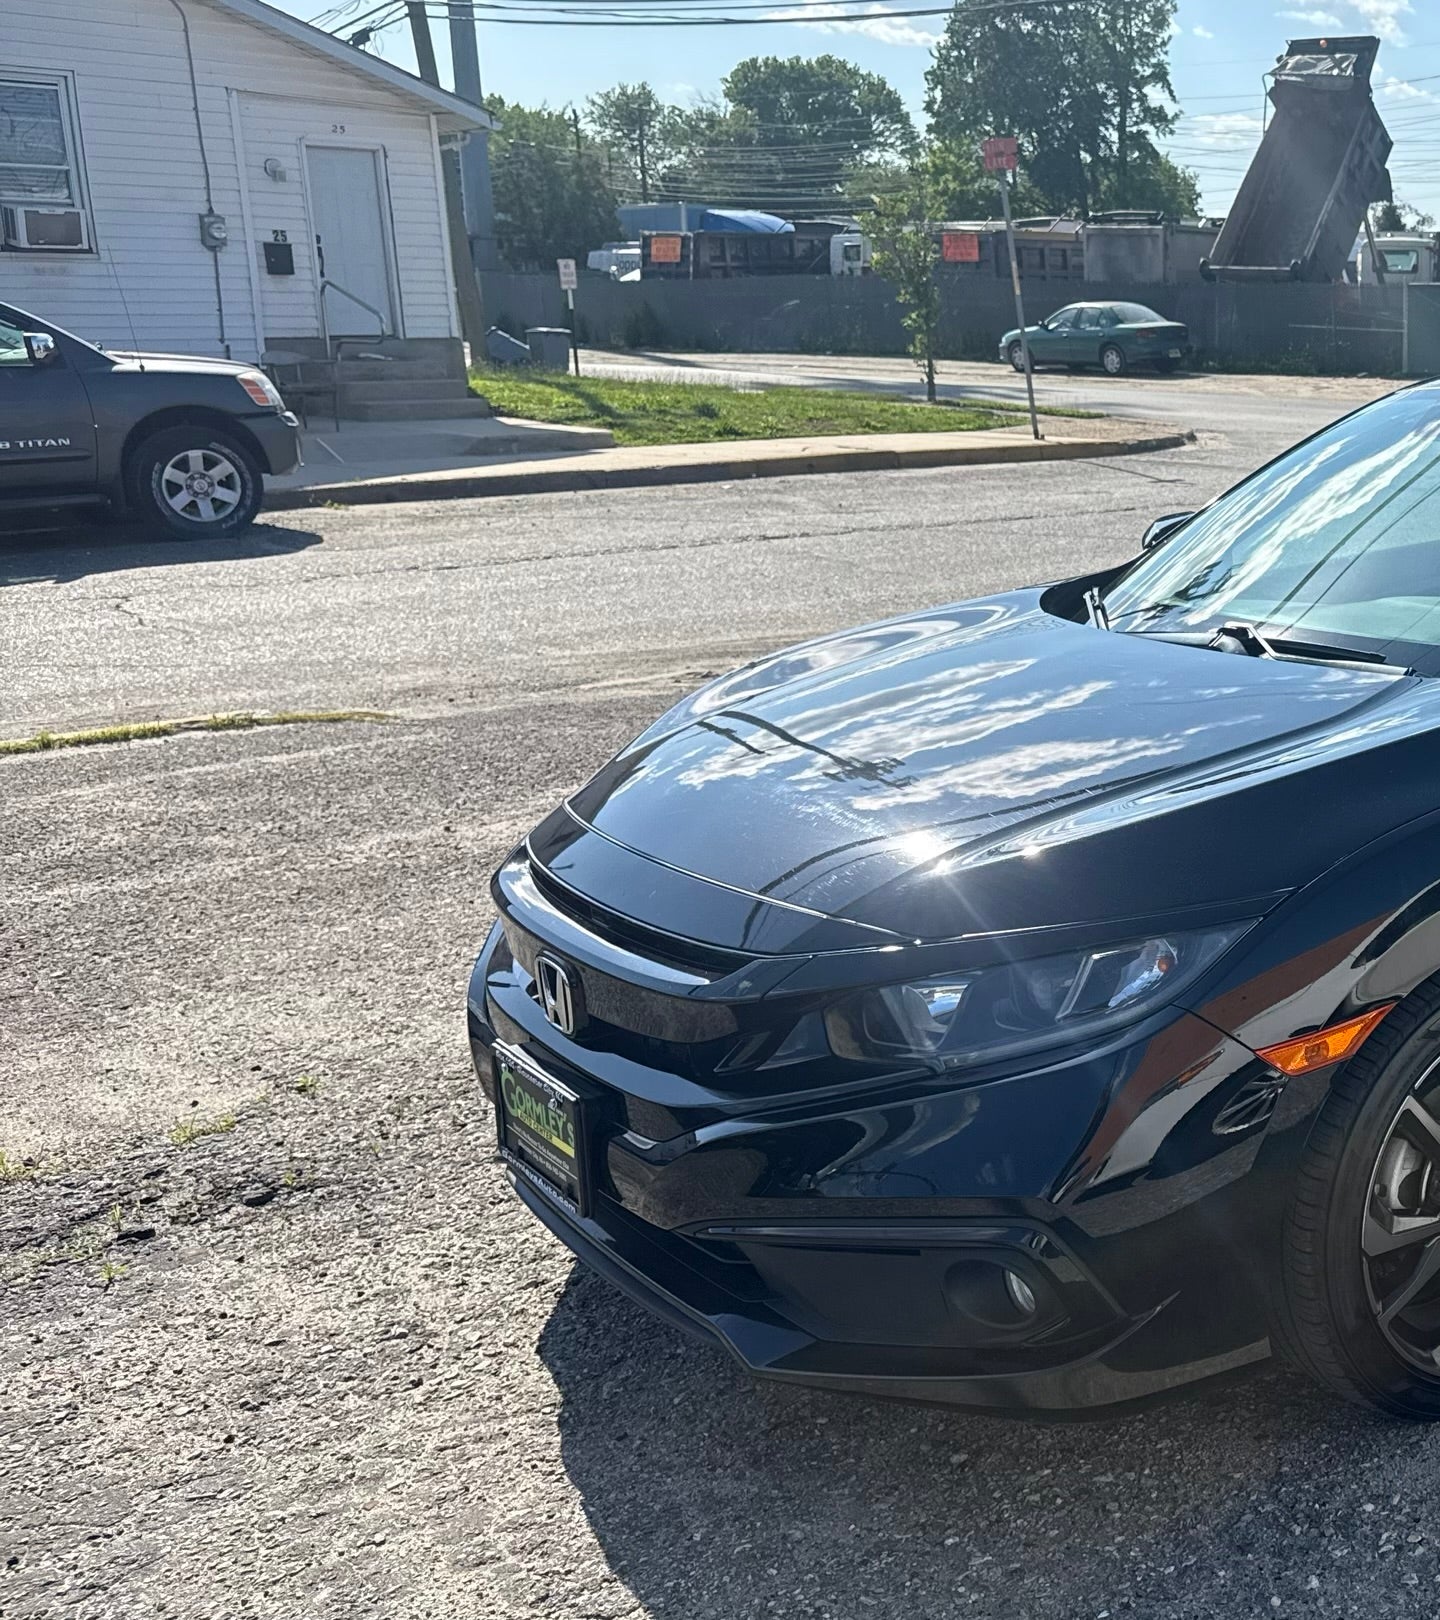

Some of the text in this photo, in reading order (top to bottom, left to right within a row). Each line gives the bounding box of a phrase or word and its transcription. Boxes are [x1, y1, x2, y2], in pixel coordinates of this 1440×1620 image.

[331, 124, 346, 135] 25
[272, 229, 288, 243] 25
[14, 437, 71, 449] TITAN
[501, 1071, 575, 1147] GORMLEY'S
